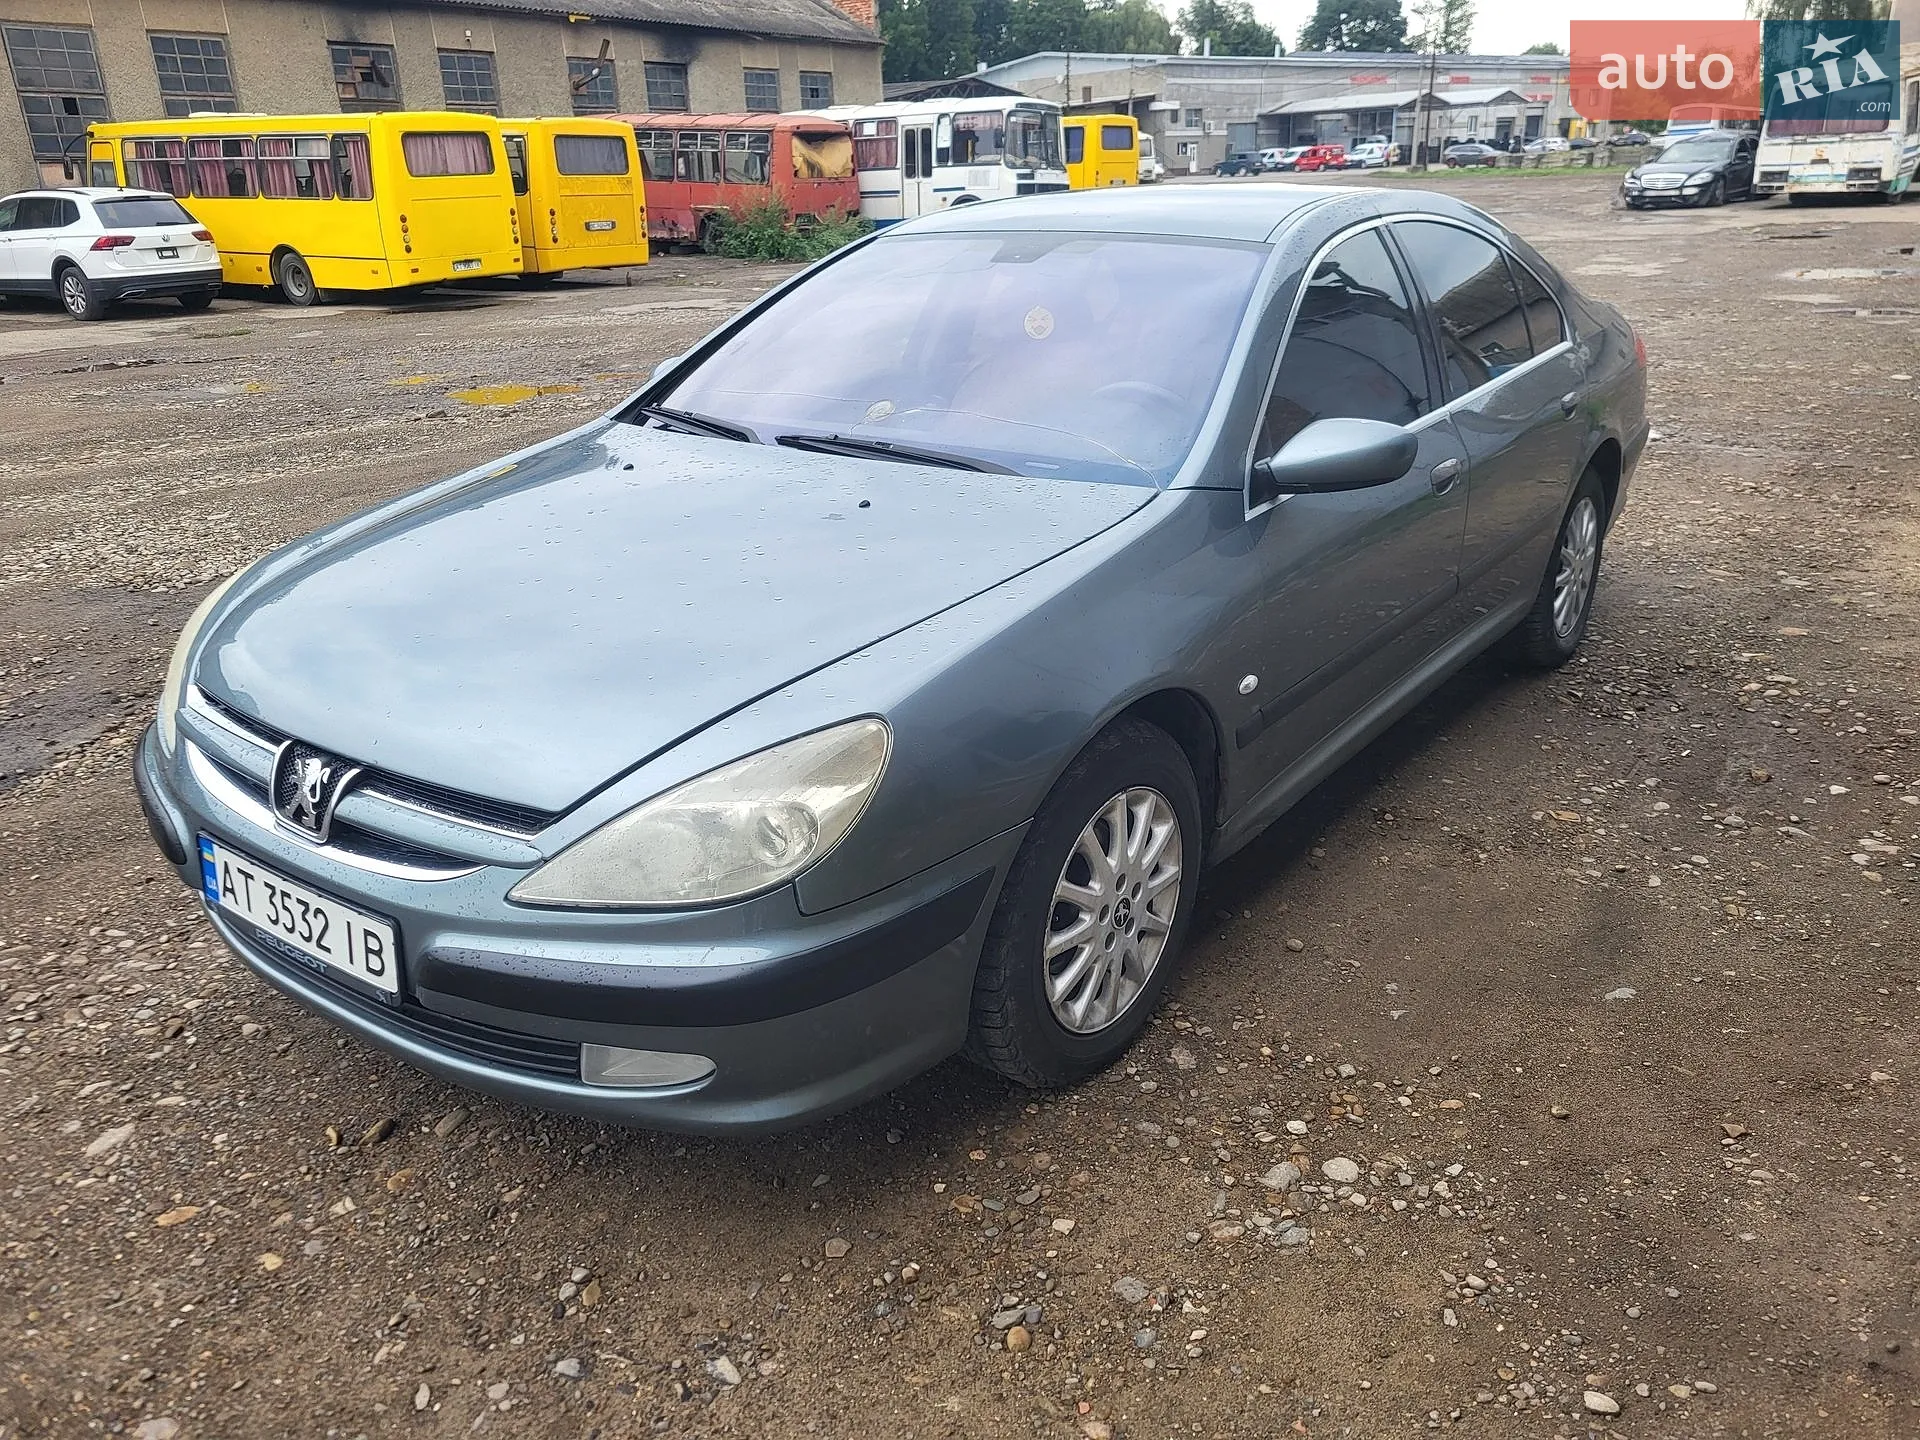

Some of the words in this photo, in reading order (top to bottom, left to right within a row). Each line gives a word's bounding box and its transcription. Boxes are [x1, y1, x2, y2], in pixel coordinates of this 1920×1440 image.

[222, 860, 255, 913] AT
[264, 884, 332, 954] 3532
[346, 920, 385, 977] IB
[255, 928, 327, 973] PEUGEOT
